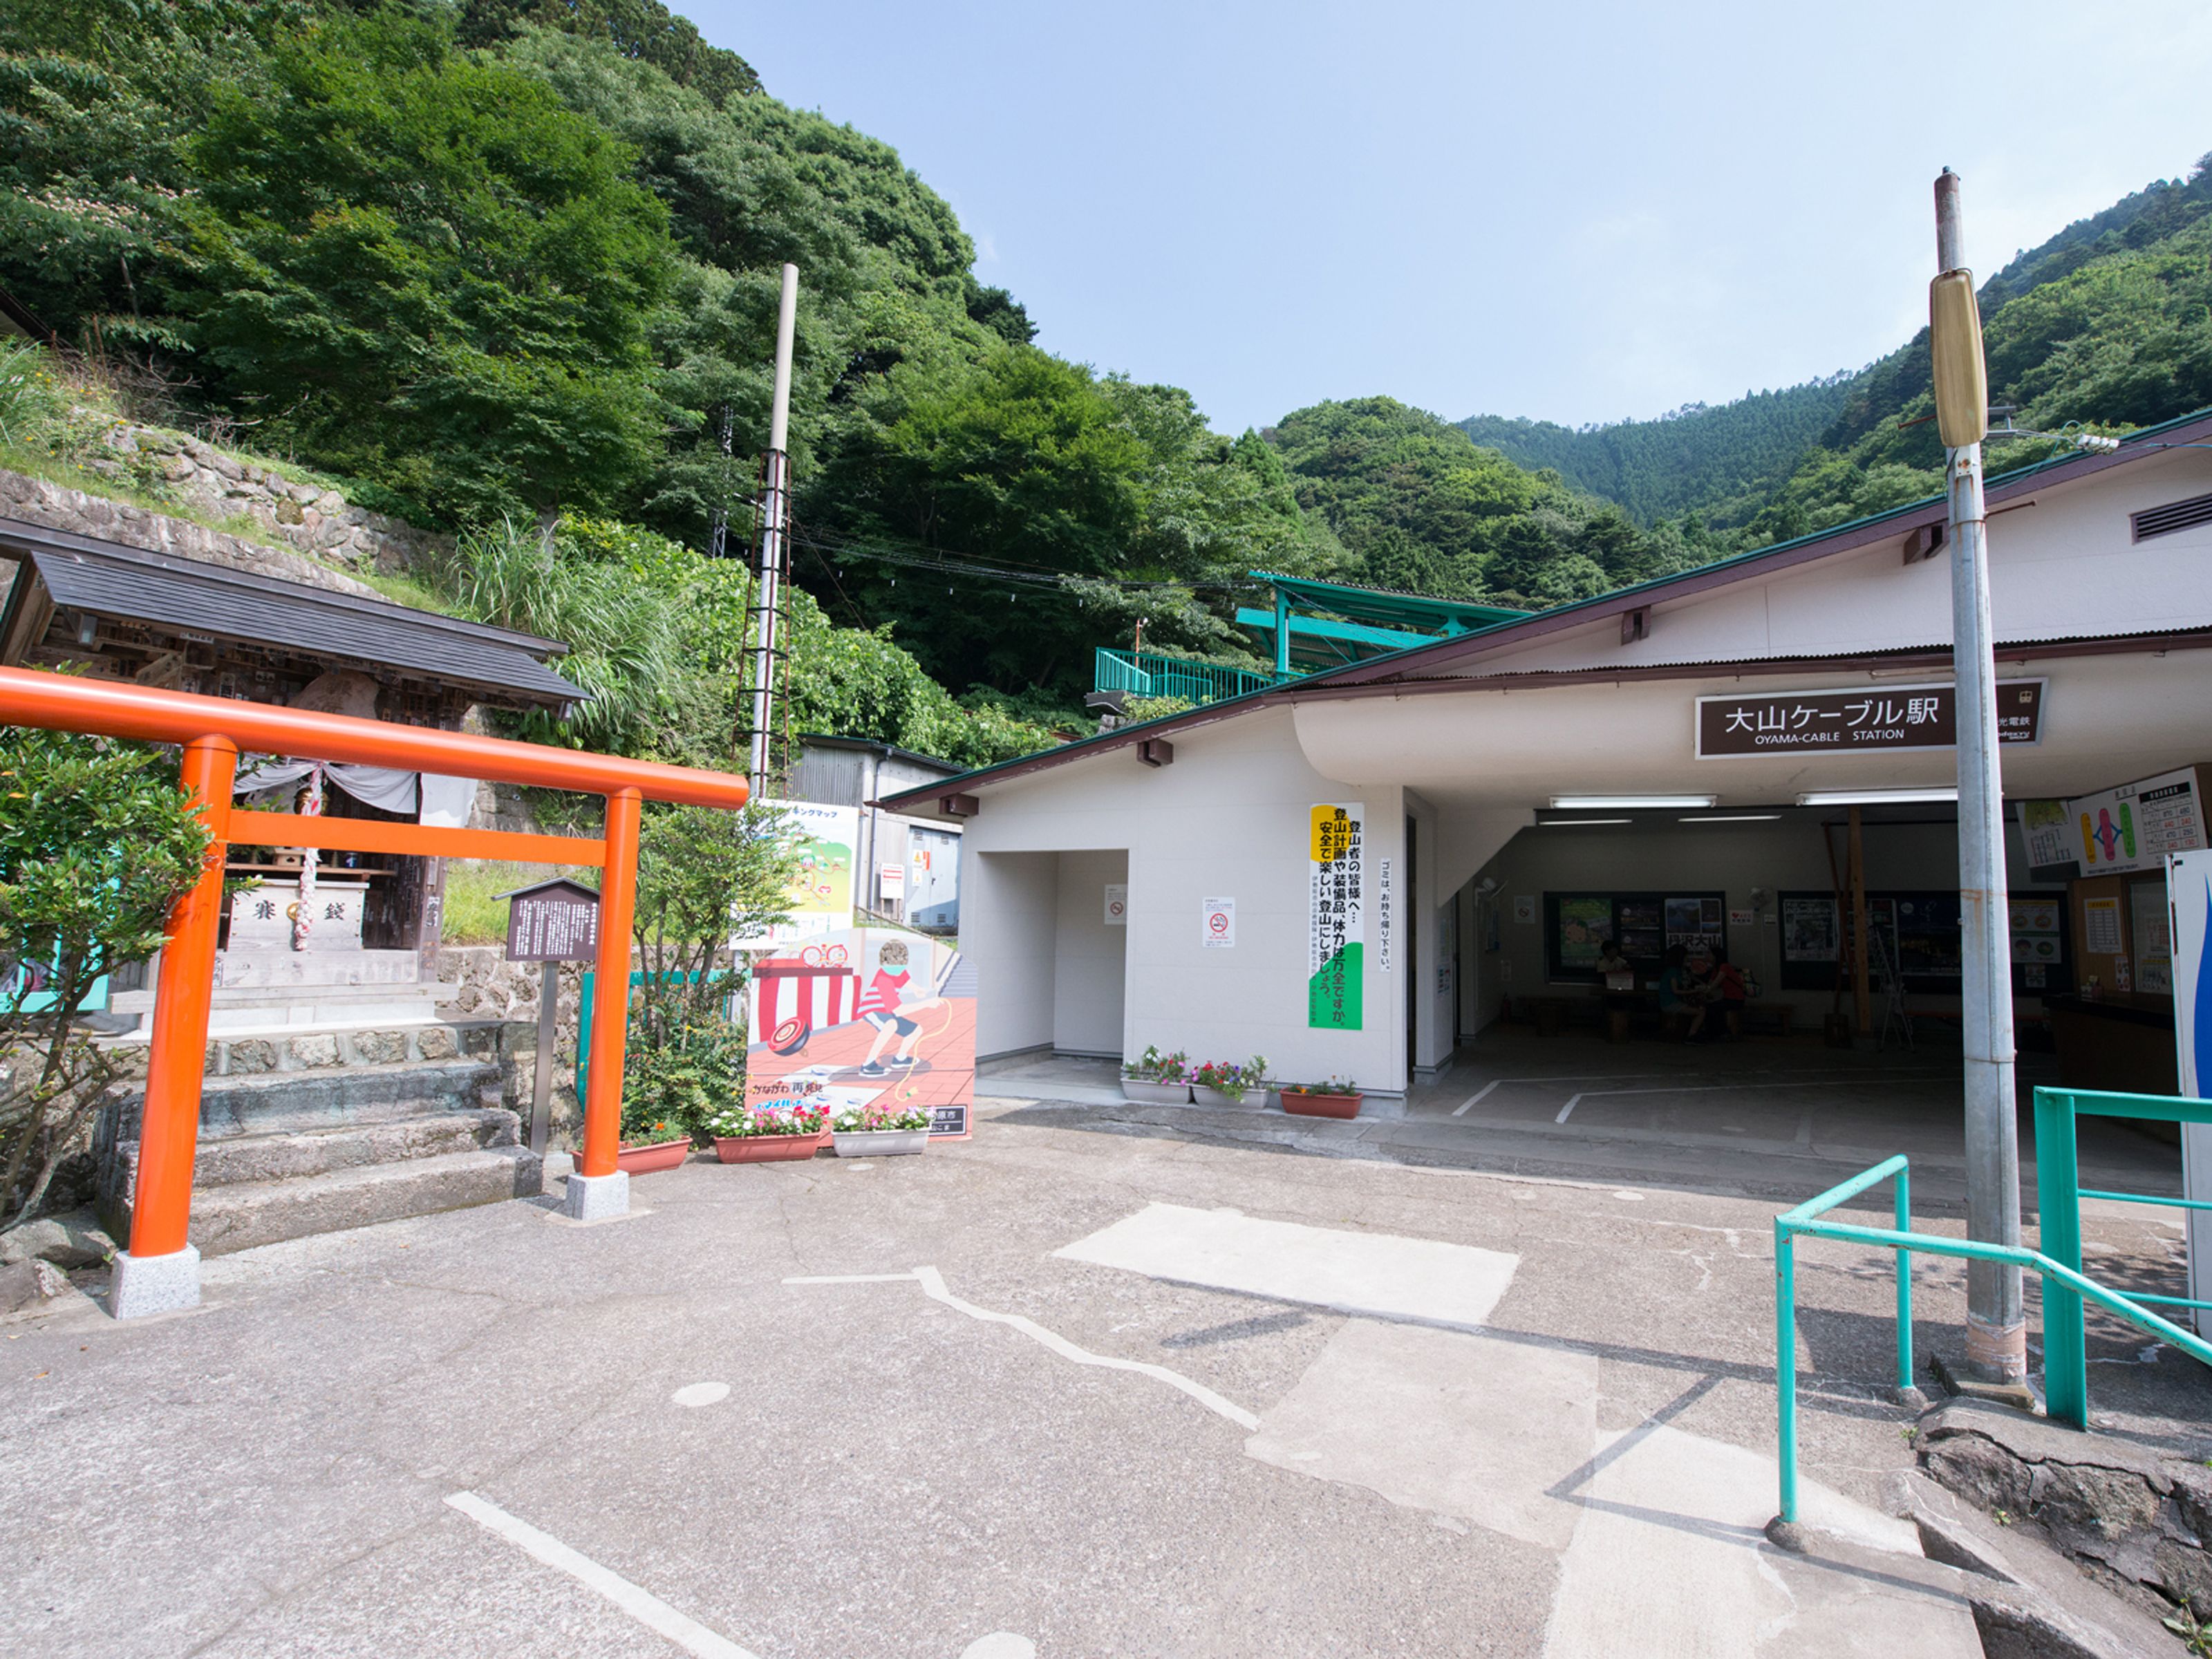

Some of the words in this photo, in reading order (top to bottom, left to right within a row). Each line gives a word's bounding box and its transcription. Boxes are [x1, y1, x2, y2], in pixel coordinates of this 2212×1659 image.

[1725, 697, 1939, 733] 大山ケーブル駅
[1754, 731, 1840, 744] OYAMA-CABLE
[1853, 729, 1905, 740] STATION
[1318, 821, 1333, 998] 安全で楽しい登山にしましょう。
[1333, 807, 1347, 1026] 登山計画や装備品、体力は万全ですか。
[1380, 860, 1391, 970] ゴミは、お持ち帰り下さい。
[1669, 934, 1721, 947] 丹沢大山
